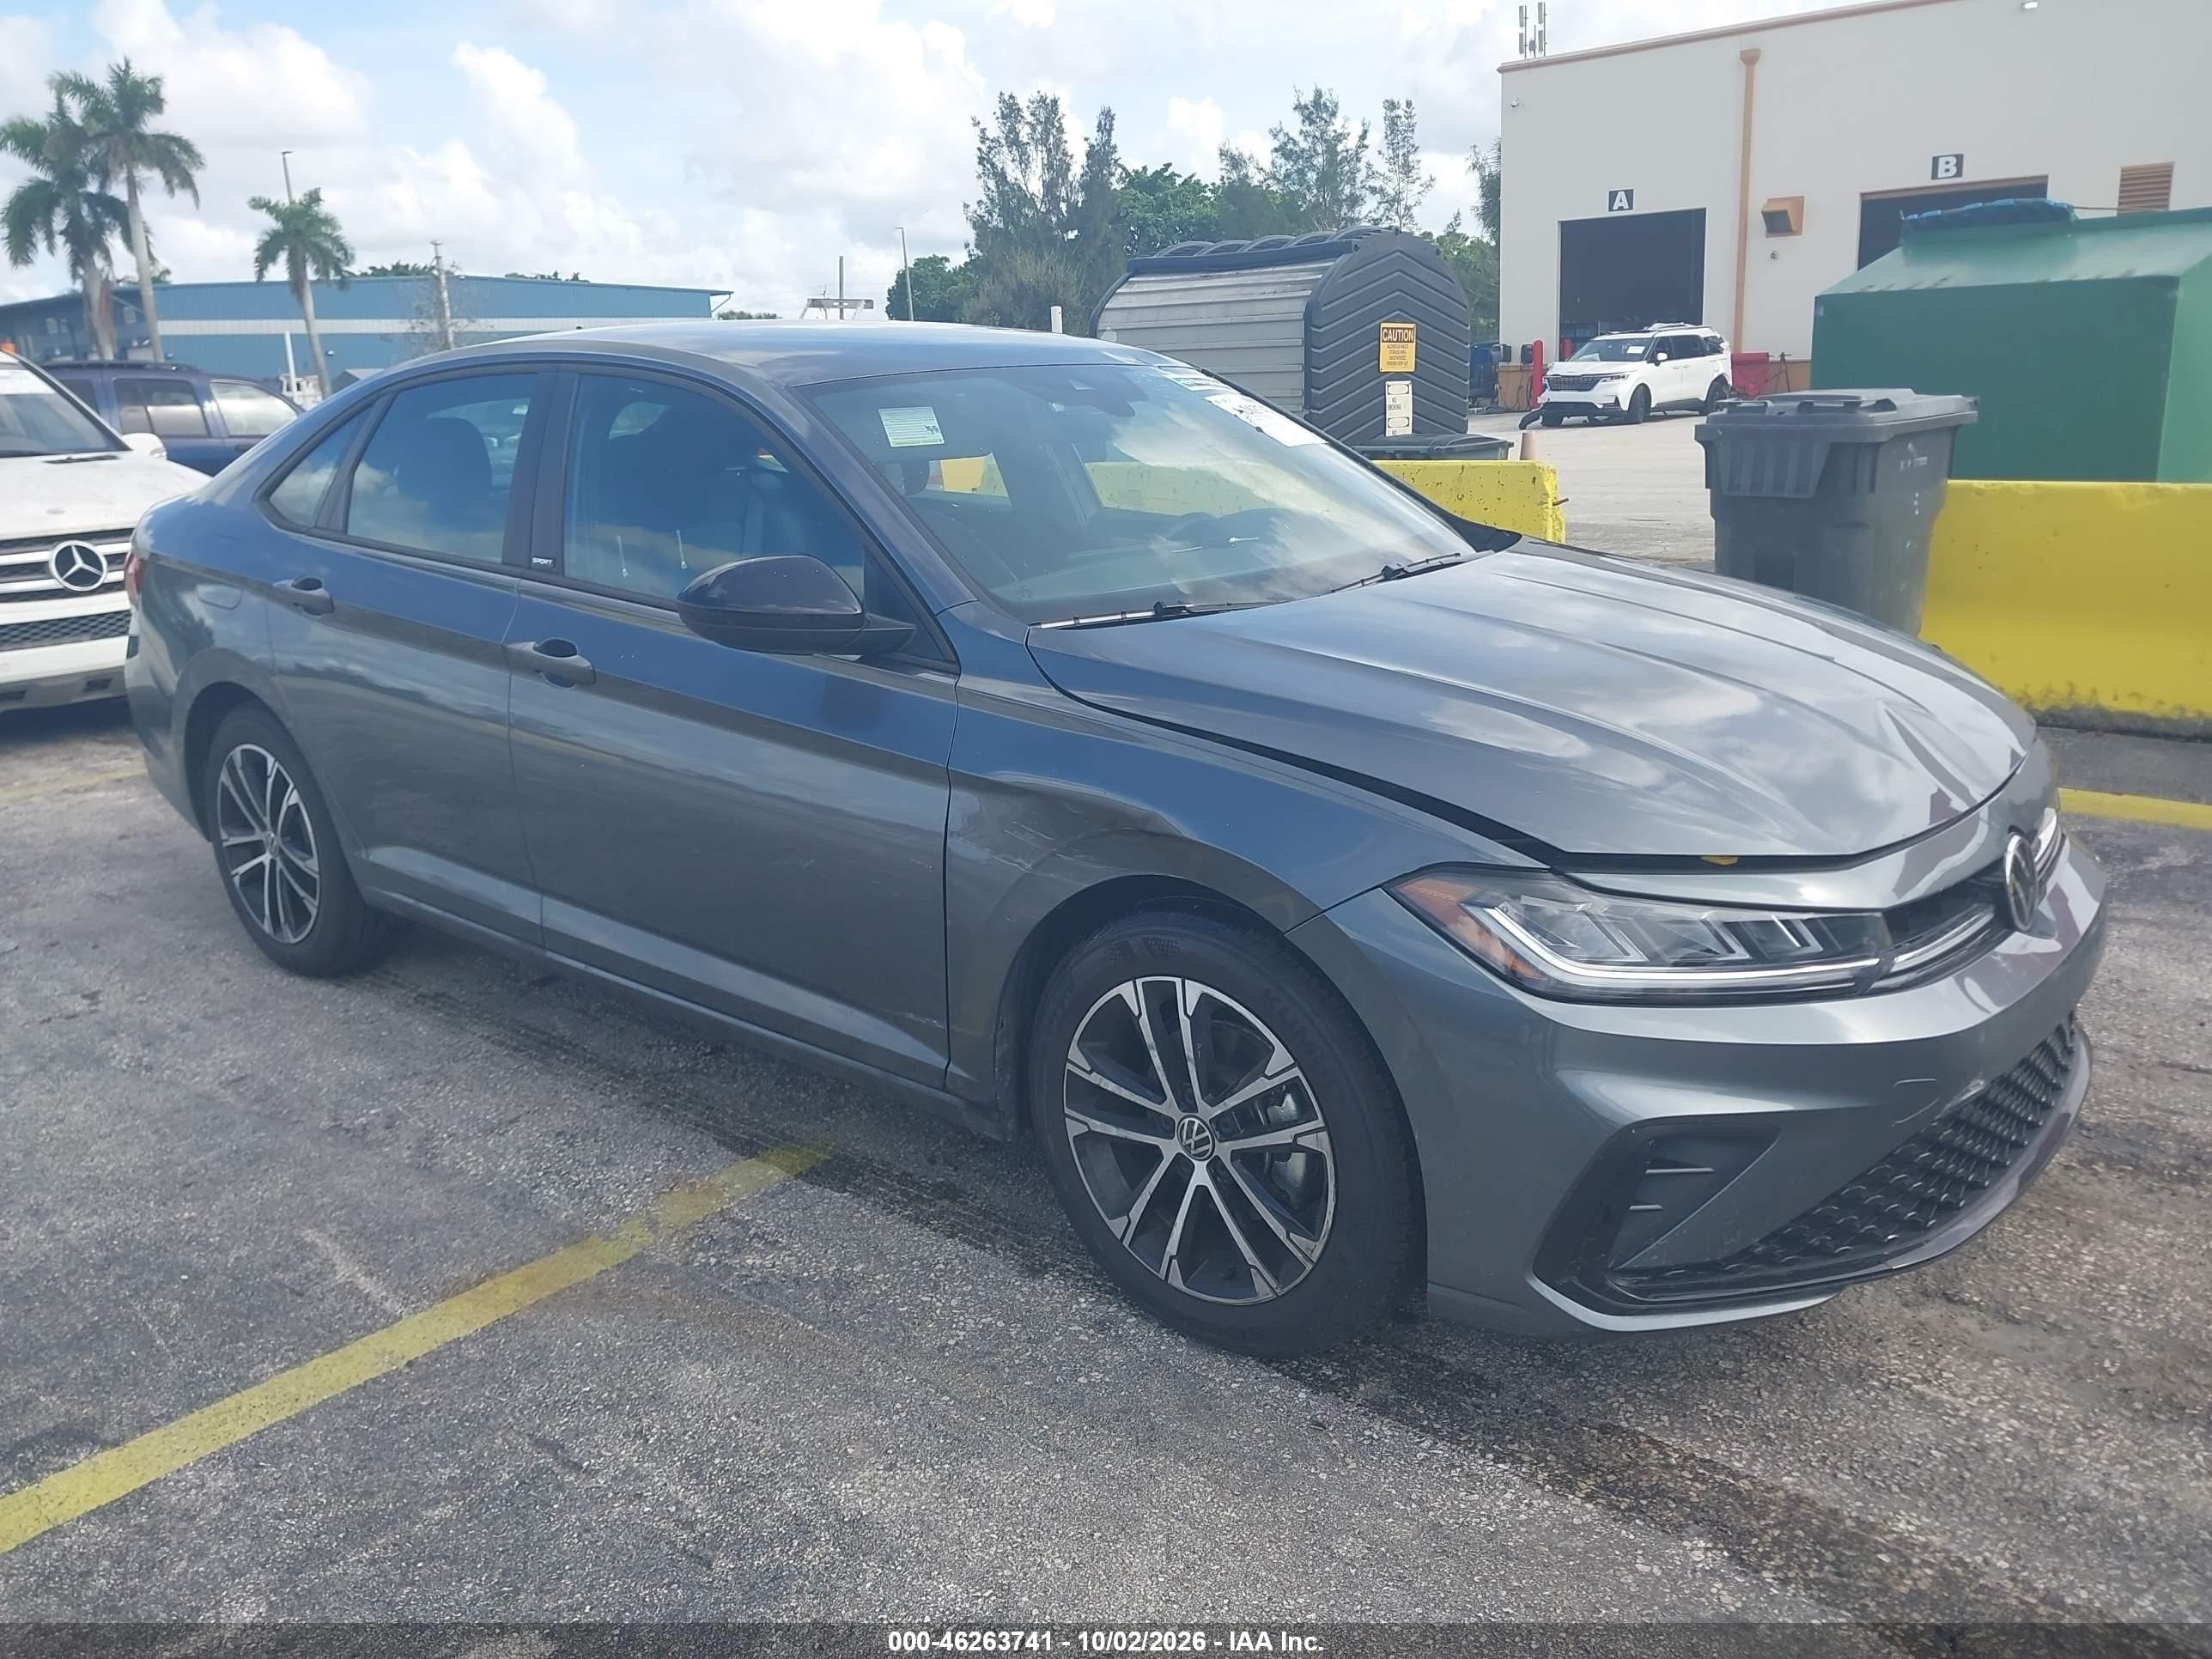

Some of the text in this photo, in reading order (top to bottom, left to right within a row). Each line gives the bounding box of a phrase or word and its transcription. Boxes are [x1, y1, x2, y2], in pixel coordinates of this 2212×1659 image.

[1937, 155, 1957, 179] B
[1613, 191, 1629, 210] A
[1382, 329, 1413, 341] CAUTION
